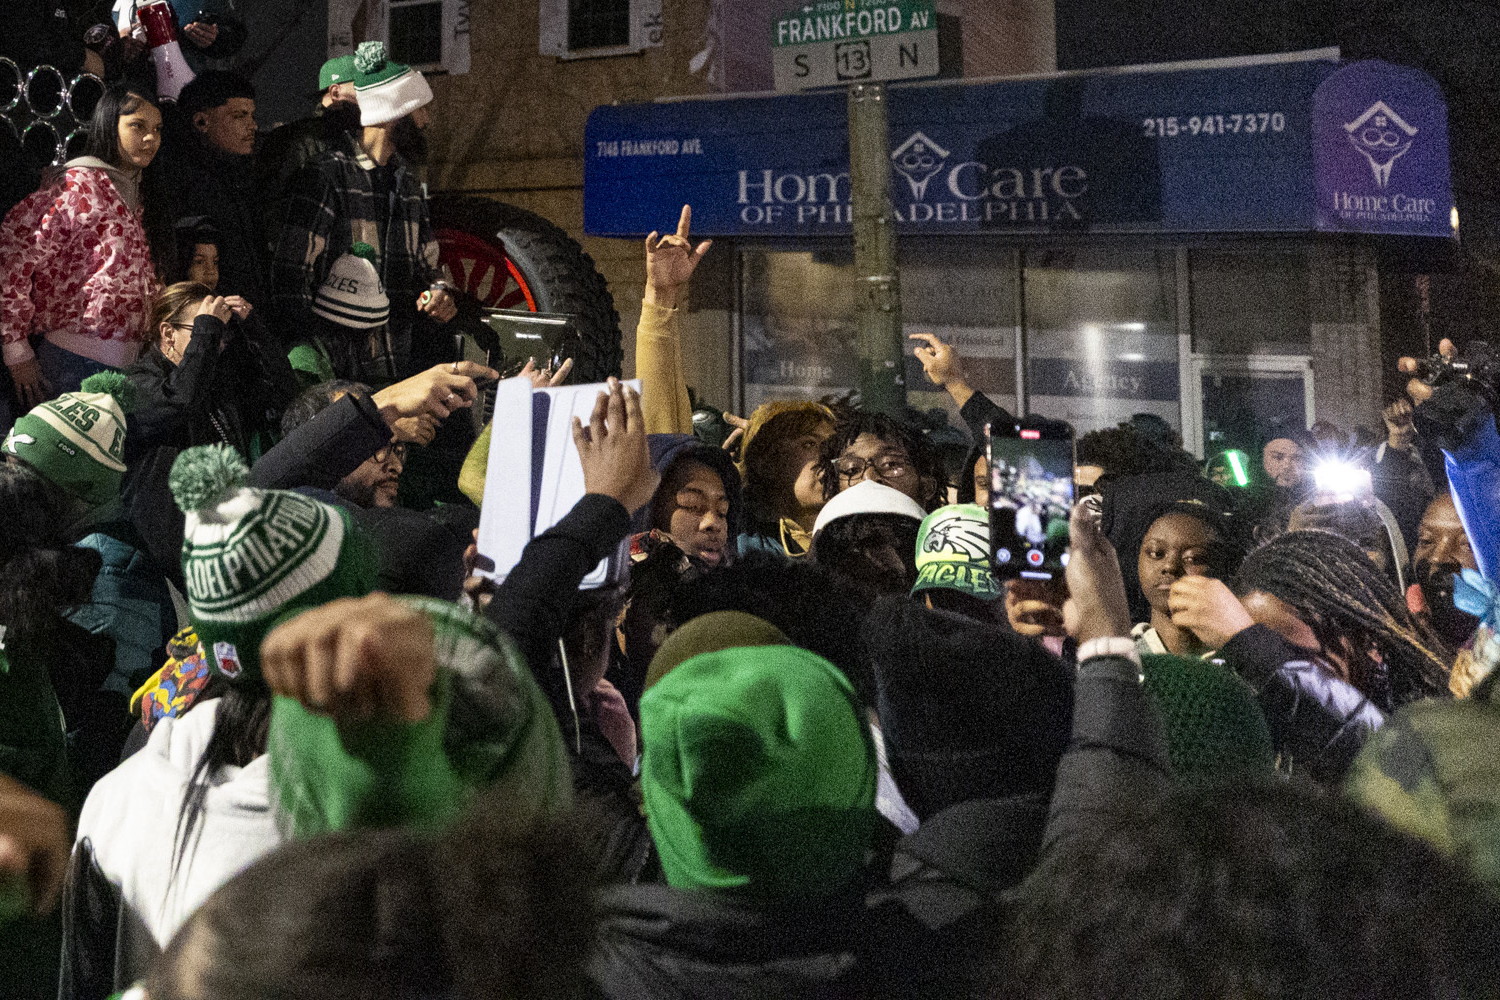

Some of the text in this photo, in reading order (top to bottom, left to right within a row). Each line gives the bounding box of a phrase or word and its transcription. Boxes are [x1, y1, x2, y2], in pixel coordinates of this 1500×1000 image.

[778, 6, 929, 44] FRANKFORD AV
[794, 42, 918, 77] S 13 N
[1143, 112, 1285, 138] 215-941-7370
[621, 140, 679, 156] FRANKFORD
[737, 161, 1088, 204] Hom Care
[741, 201, 1082, 225] OF PHIDELPHIA
[1334, 191, 1436, 214] Home Care
[779, 361, 833, 379] Home
[48, 395, 101, 433] LES
